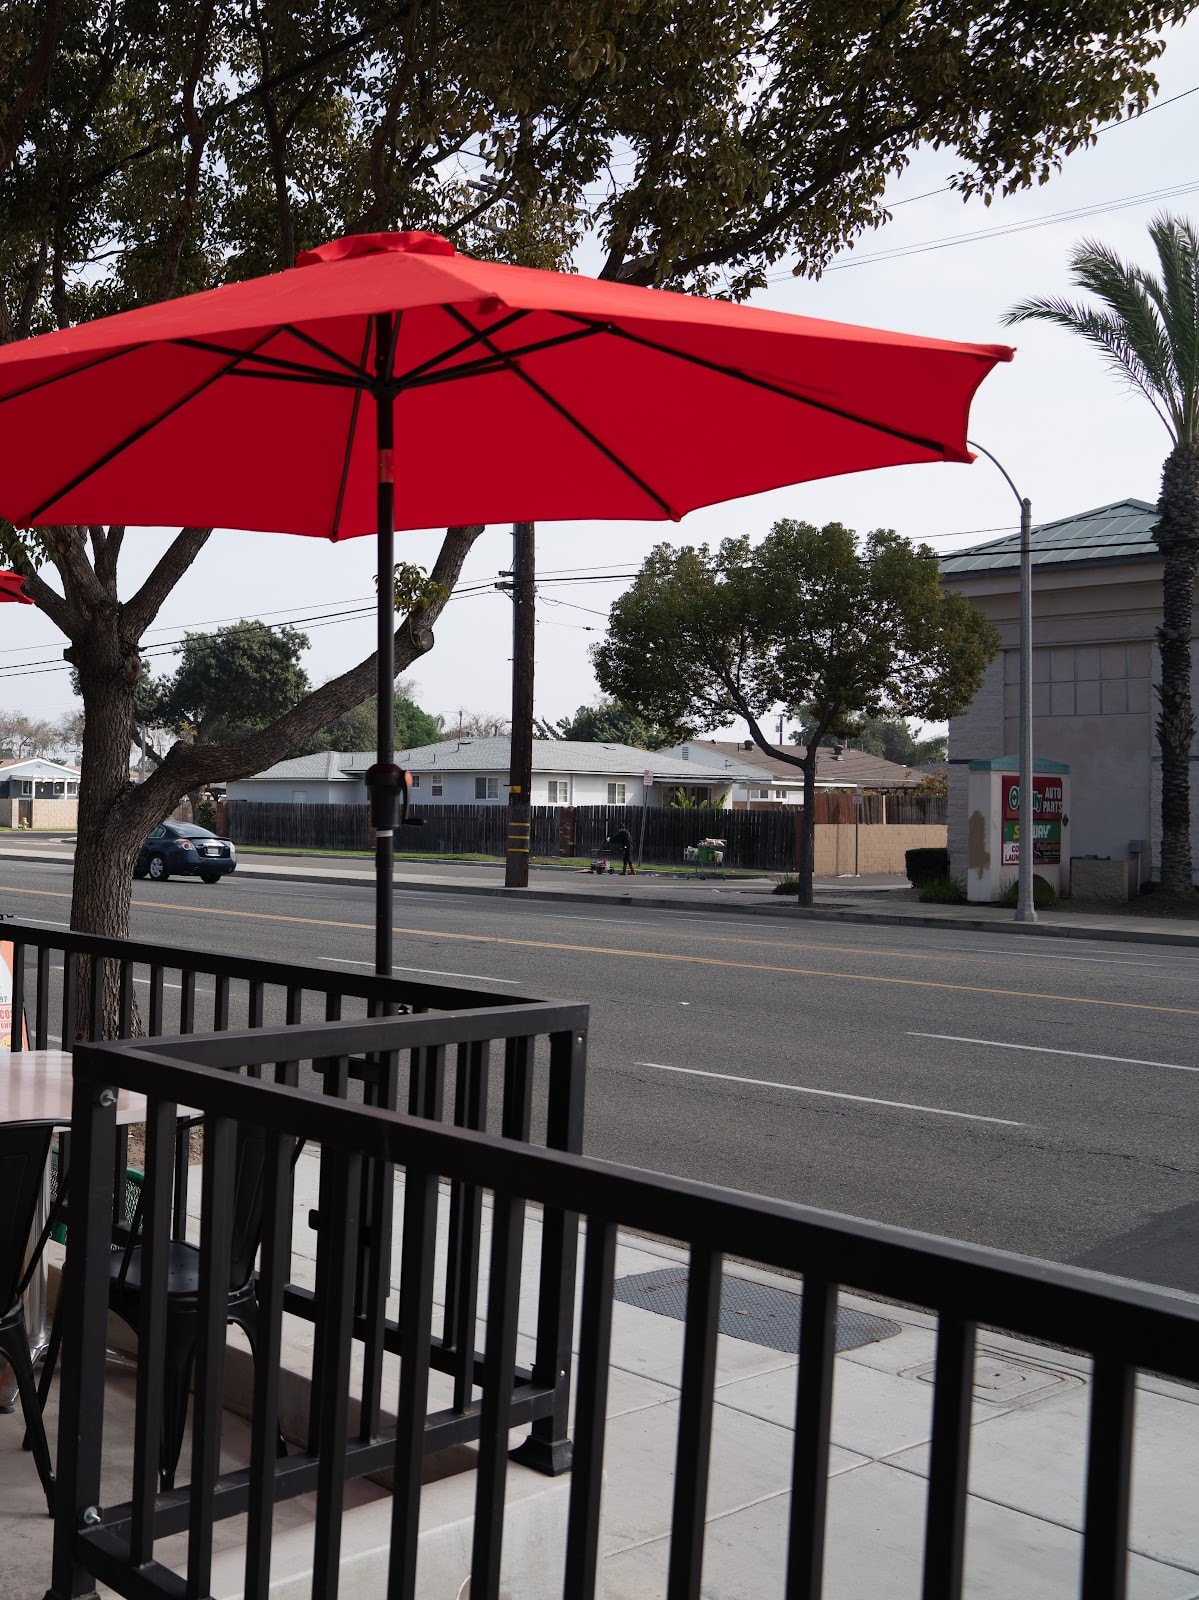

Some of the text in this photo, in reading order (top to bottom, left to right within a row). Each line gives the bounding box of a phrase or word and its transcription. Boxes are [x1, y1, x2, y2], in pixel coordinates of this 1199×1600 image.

[1045, 787, 1061, 798] AUTO
[1043, 801, 1063, 813] PARTS
[1013, 825, 1050, 839] SWAY
